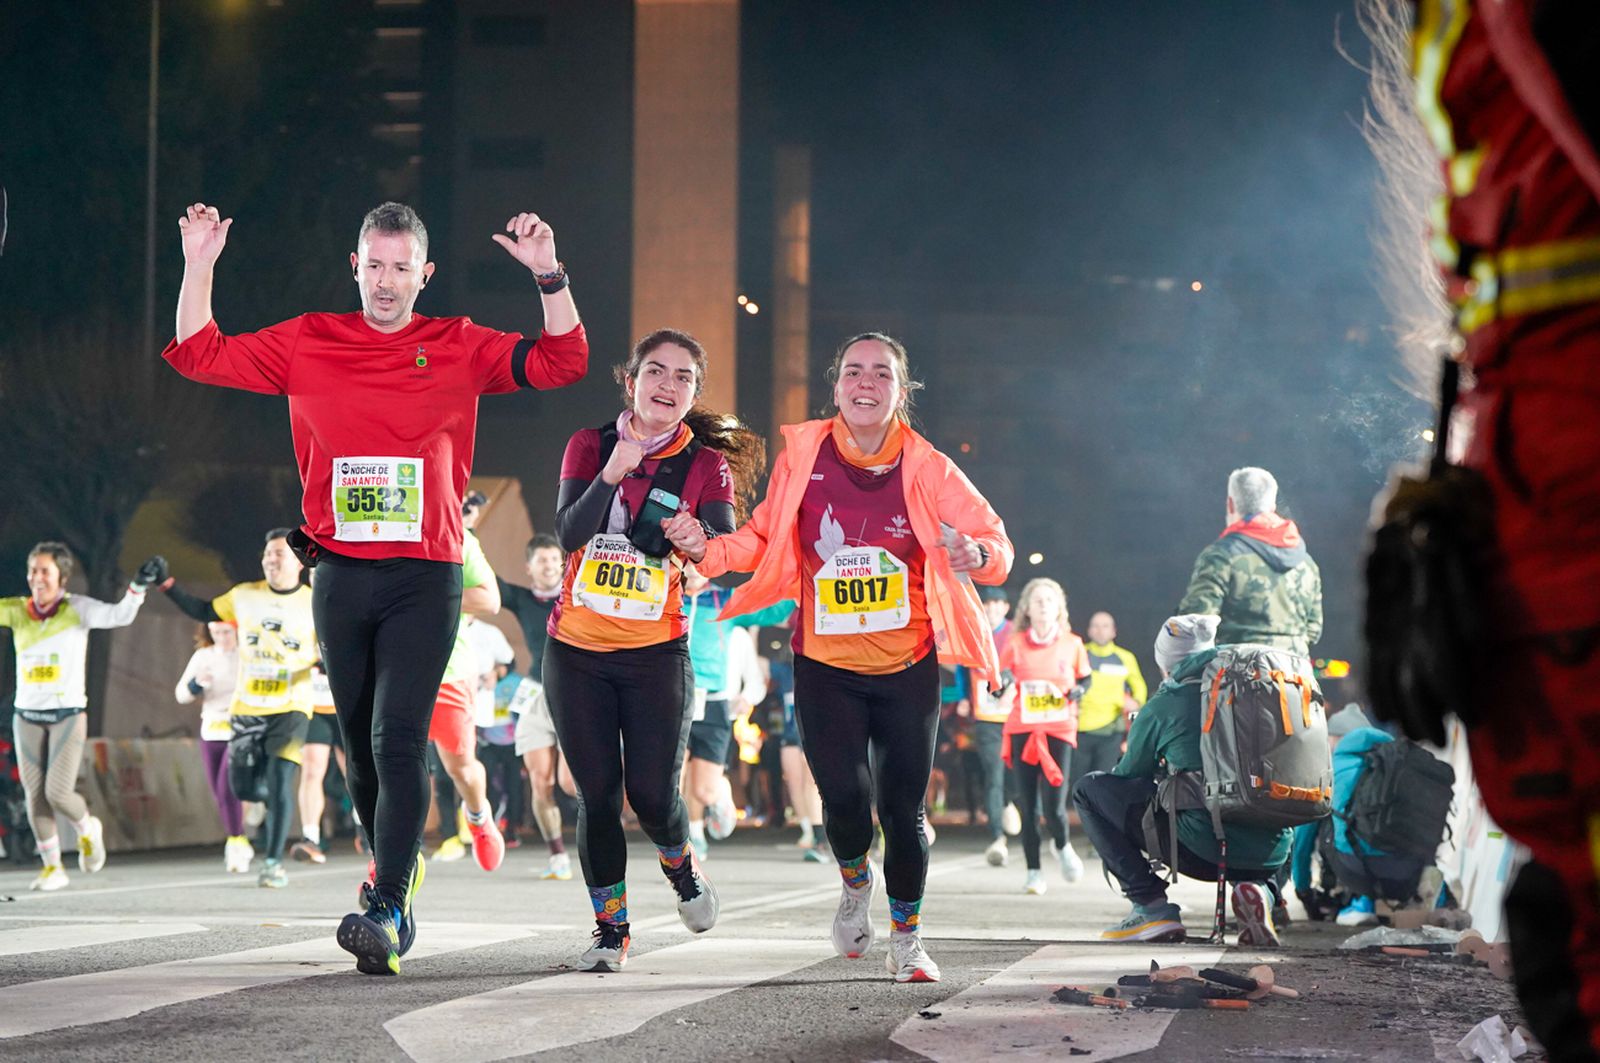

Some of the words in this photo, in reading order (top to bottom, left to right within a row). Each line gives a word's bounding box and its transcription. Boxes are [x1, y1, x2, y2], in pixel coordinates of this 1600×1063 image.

[351, 466, 377, 475] NOCHE
[378, 466, 389, 475] DE
[342, 477, 358, 486] SAN
[359, 475, 389, 486] ANTÓN
[347, 487, 407, 513] 5532
[604, 543, 627, 552] NOCHE
[627, 546, 638, 555] DE
[593, 552, 609, 560] SAN
[860, 556, 871, 565] DE
[841, 565, 872, 577] ANTÓN
[595, 562, 652, 593] 6016
[609, 589, 629, 598] Andrea
[834, 576, 888, 605] 6017
